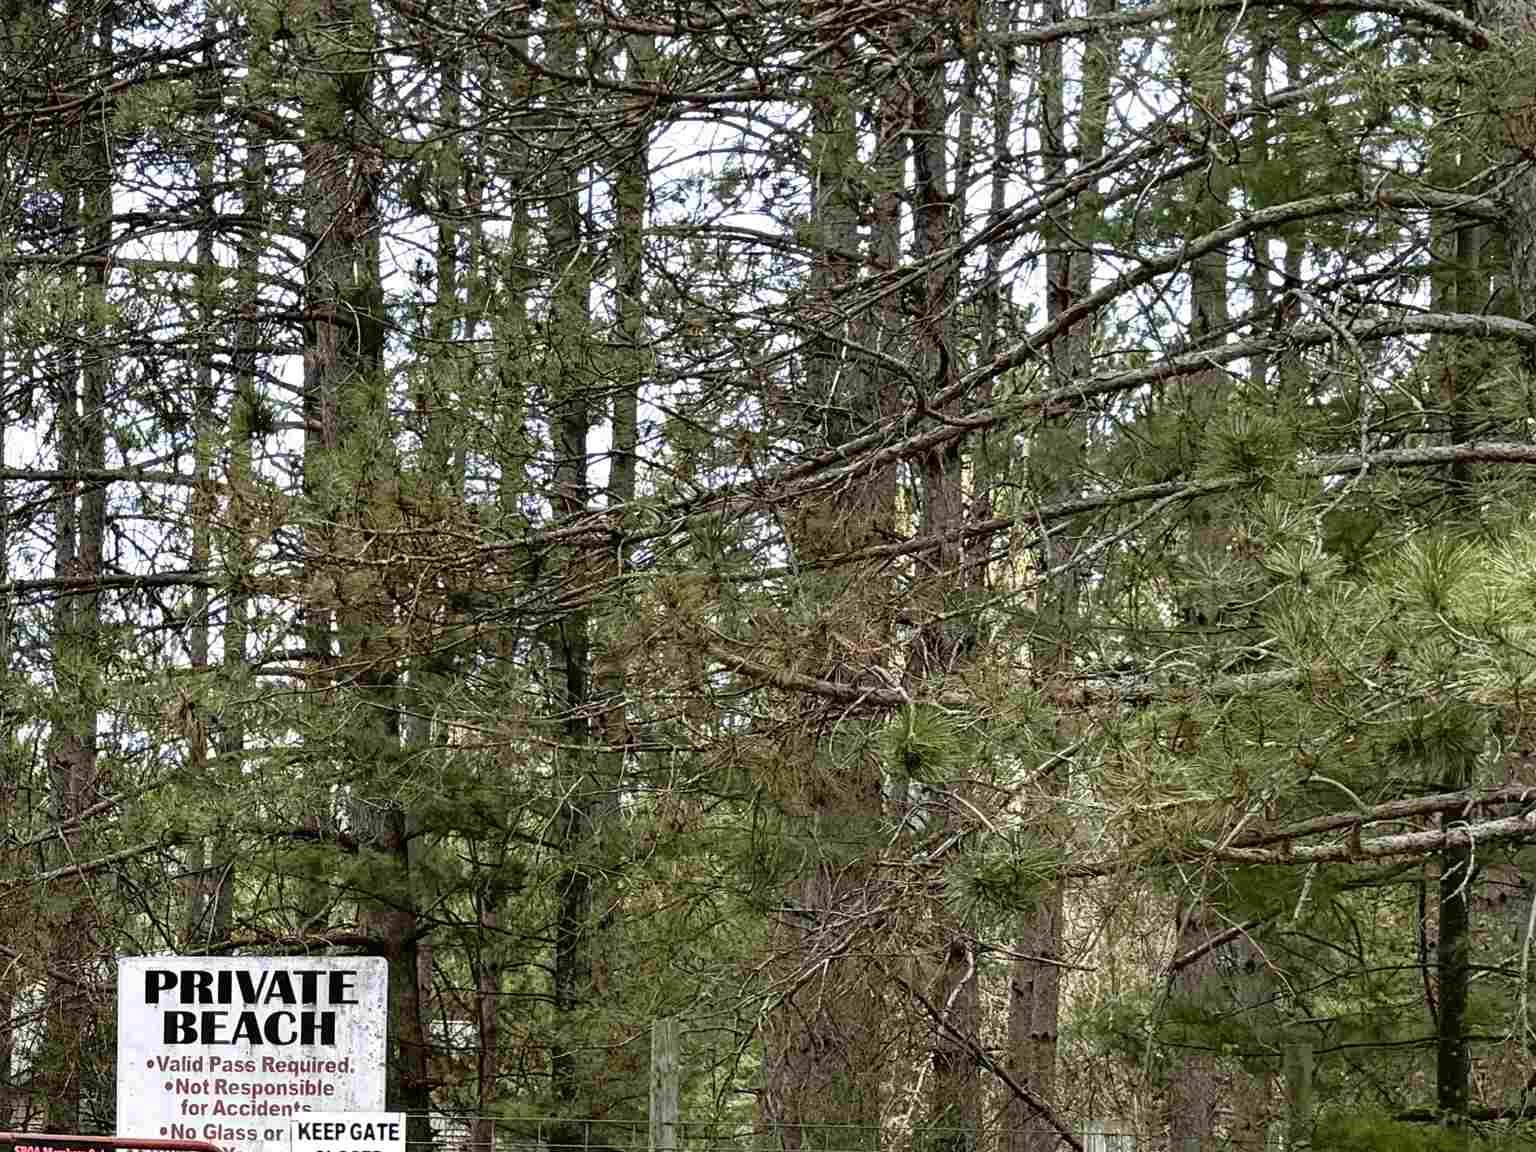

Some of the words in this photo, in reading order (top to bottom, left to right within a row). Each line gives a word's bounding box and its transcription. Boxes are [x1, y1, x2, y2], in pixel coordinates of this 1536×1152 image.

[145, 970, 358, 1005] PRIVATE
[164, 1011, 336, 1045] BEACH
[156, 1055, 203, 1072] Valid
[209, 1056, 256, 1072] Pass
[262, 1056, 355, 1077] Required.
[176, 1079, 209, 1095] Not
[215, 1078, 335, 1099] Responsible
[181, 1099, 208, 1115] for
[171, 1124, 197, 1139] No
[203, 1124, 258, 1141] Glass
[264, 1128, 284, 1141] or
[298, 1122, 346, 1141] KEEP
[350, 1122, 400, 1141] GATE
